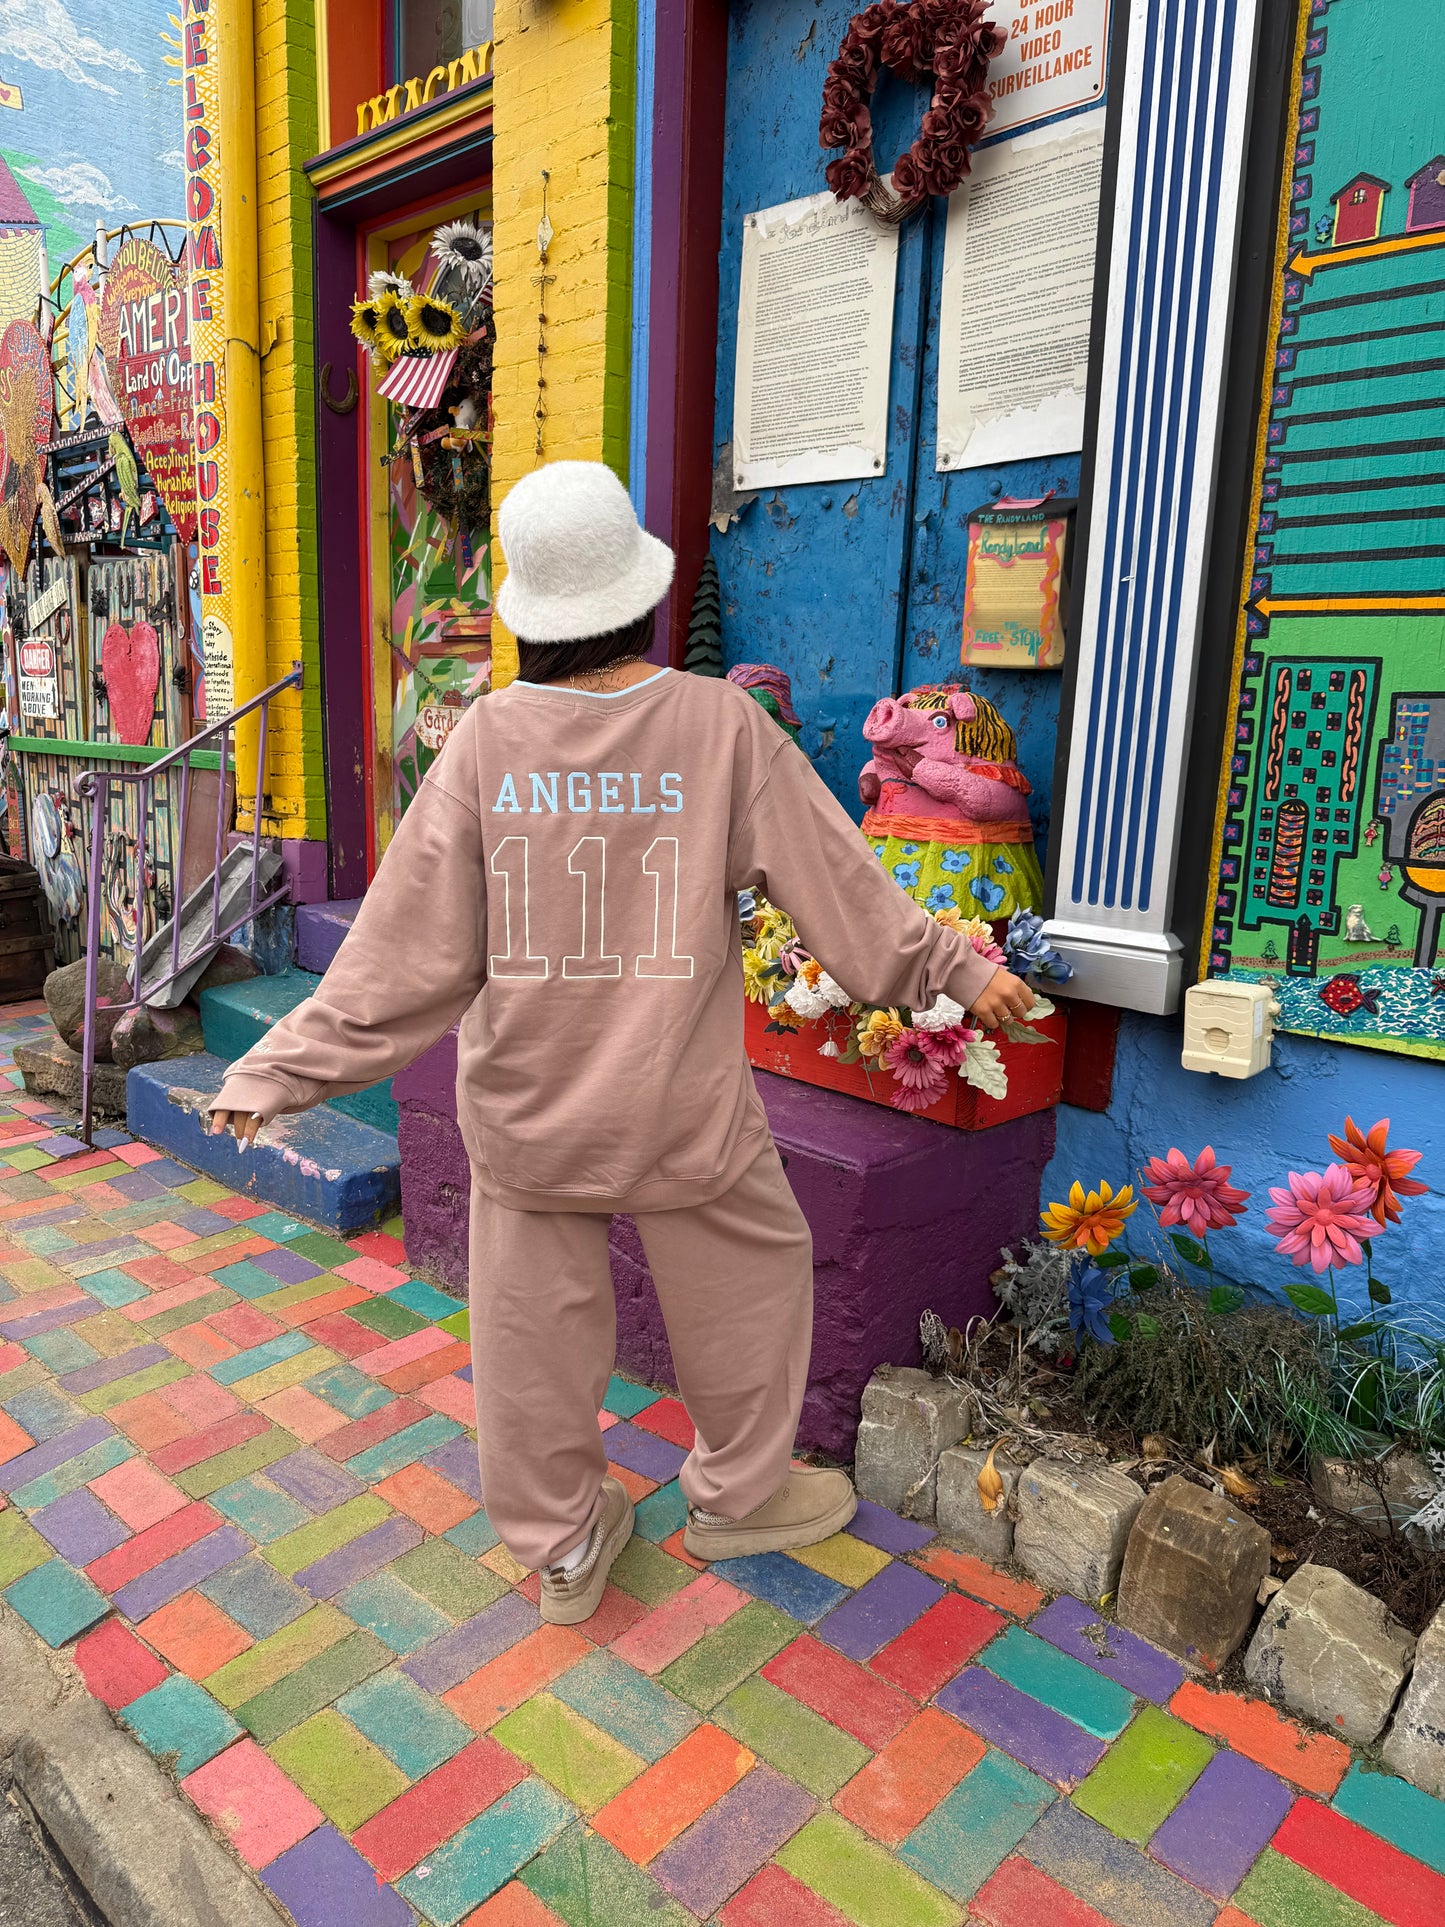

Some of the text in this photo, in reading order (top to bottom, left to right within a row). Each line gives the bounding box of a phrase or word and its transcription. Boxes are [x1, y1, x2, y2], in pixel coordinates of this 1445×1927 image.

[1011, 0, 1073, 40] 24 HOUR
[1020, 30, 1061, 63] VIDEO
[989, 45, 1092, 100] SURVEILLANCE
[117, 241, 137, 272] YOU
[137, 241, 175, 297] BELONG
[106, 268, 138, 306] Welcome
[123, 282, 157, 305] Everyone
[125, 364, 149, 394] Land
[146, 447, 189, 475] Accepting
[194, 362, 222, 595] HOUSE
[978, 512, 1045, 524] THE RANDYLAND
[23, 648, 51, 670] DANGER
[22, 680, 35, 691] MEN
[22, 691, 51, 704] WORKING
[23, 702, 46, 715] ABOVE
[491, 771, 684, 814] ANGELS
